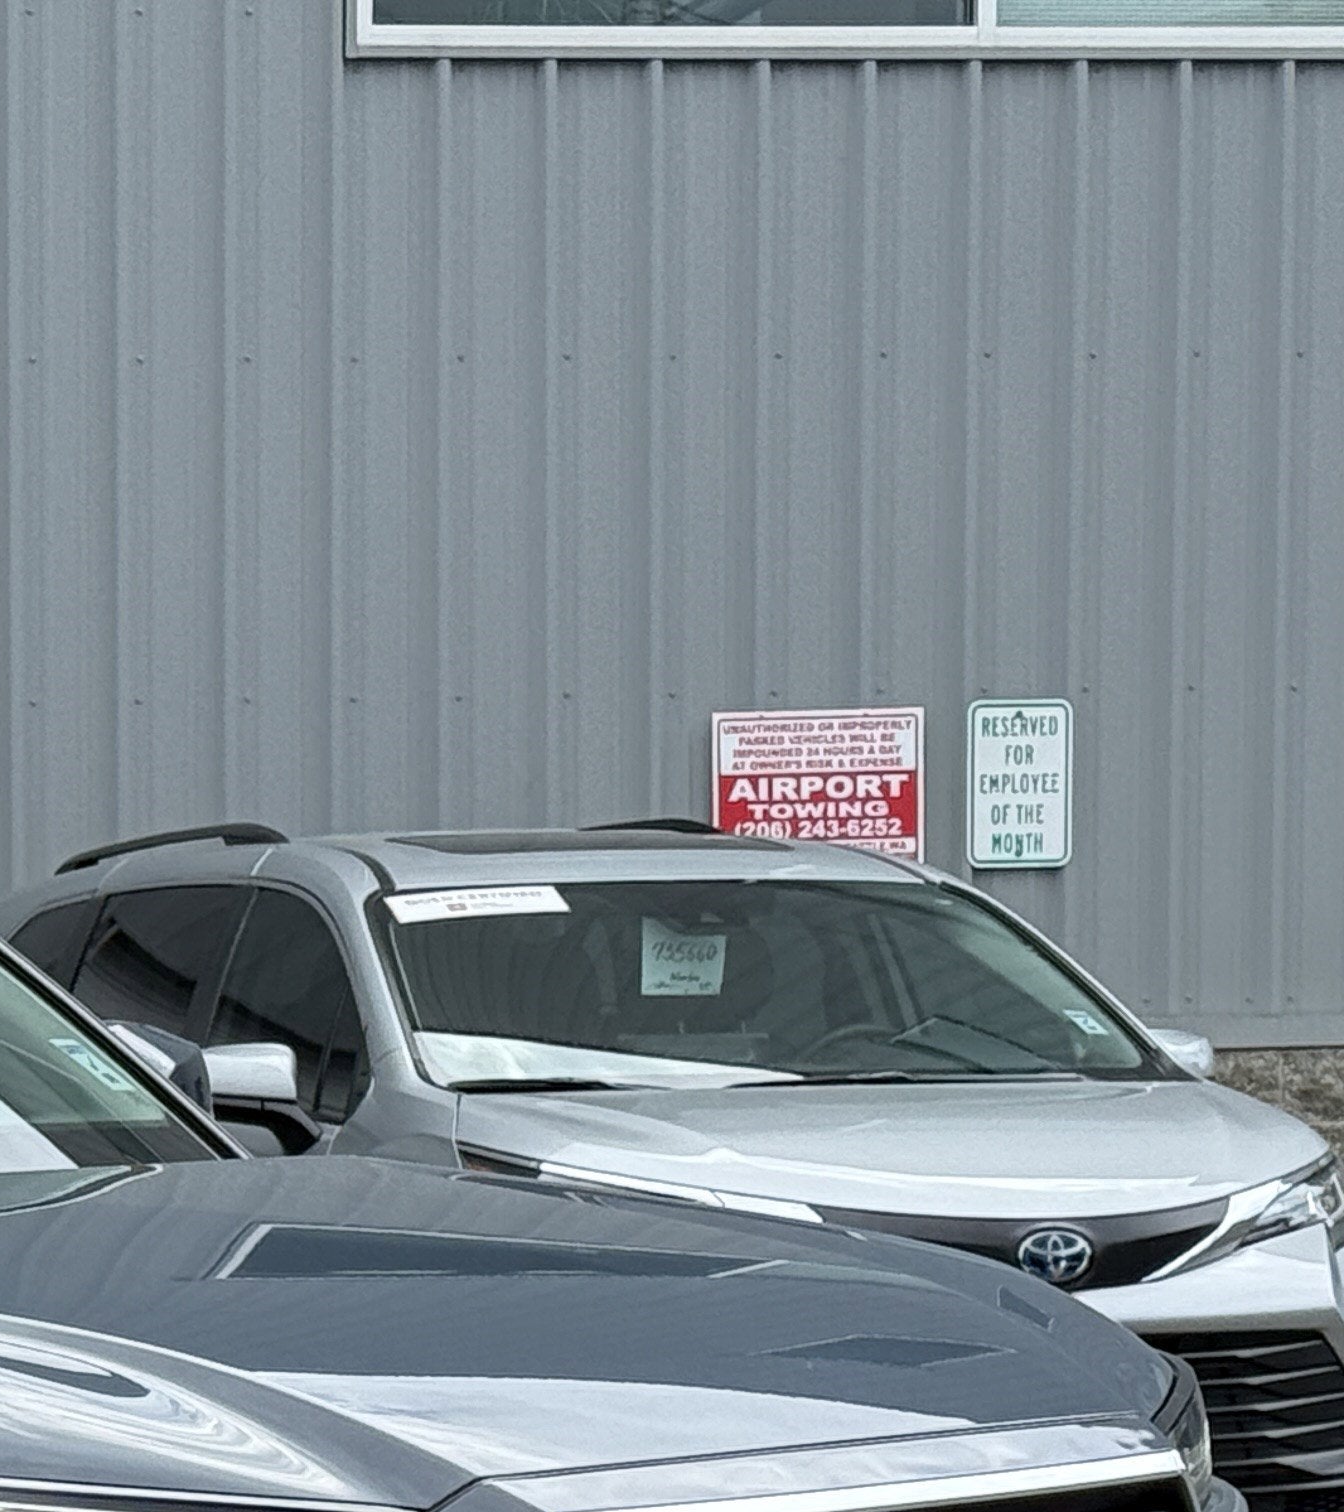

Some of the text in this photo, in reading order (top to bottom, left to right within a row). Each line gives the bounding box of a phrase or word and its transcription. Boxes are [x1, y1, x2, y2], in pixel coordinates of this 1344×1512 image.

[818, 722, 834, 732] OR
[981, 715, 1059, 737] RESERVED
[738, 732, 895, 746] PARKED VEHICLES WILL BE
[807, 746, 820, 756] 24
[823, 746, 863, 756] HOURS
[867, 745, 875, 755] A
[878, 744, 902, 754] DAY
[1005, 744, 1034, 766] FOR
[732, 761, 746, 771] AT
[806, 759, 834, 769] RISK
[849, 757, 903, 768] EXPENSE
[727, 774, 909, 802] AIRPORT
[979, 773, 1060, 795] EMPLOYEE
[747, 800, 889, 819] TOWING
[991, 804, 1044, 825] OF THE
[735, 818, 902, 839] (206) 243-6252
[991, 832, 1044, 854] MONTH
